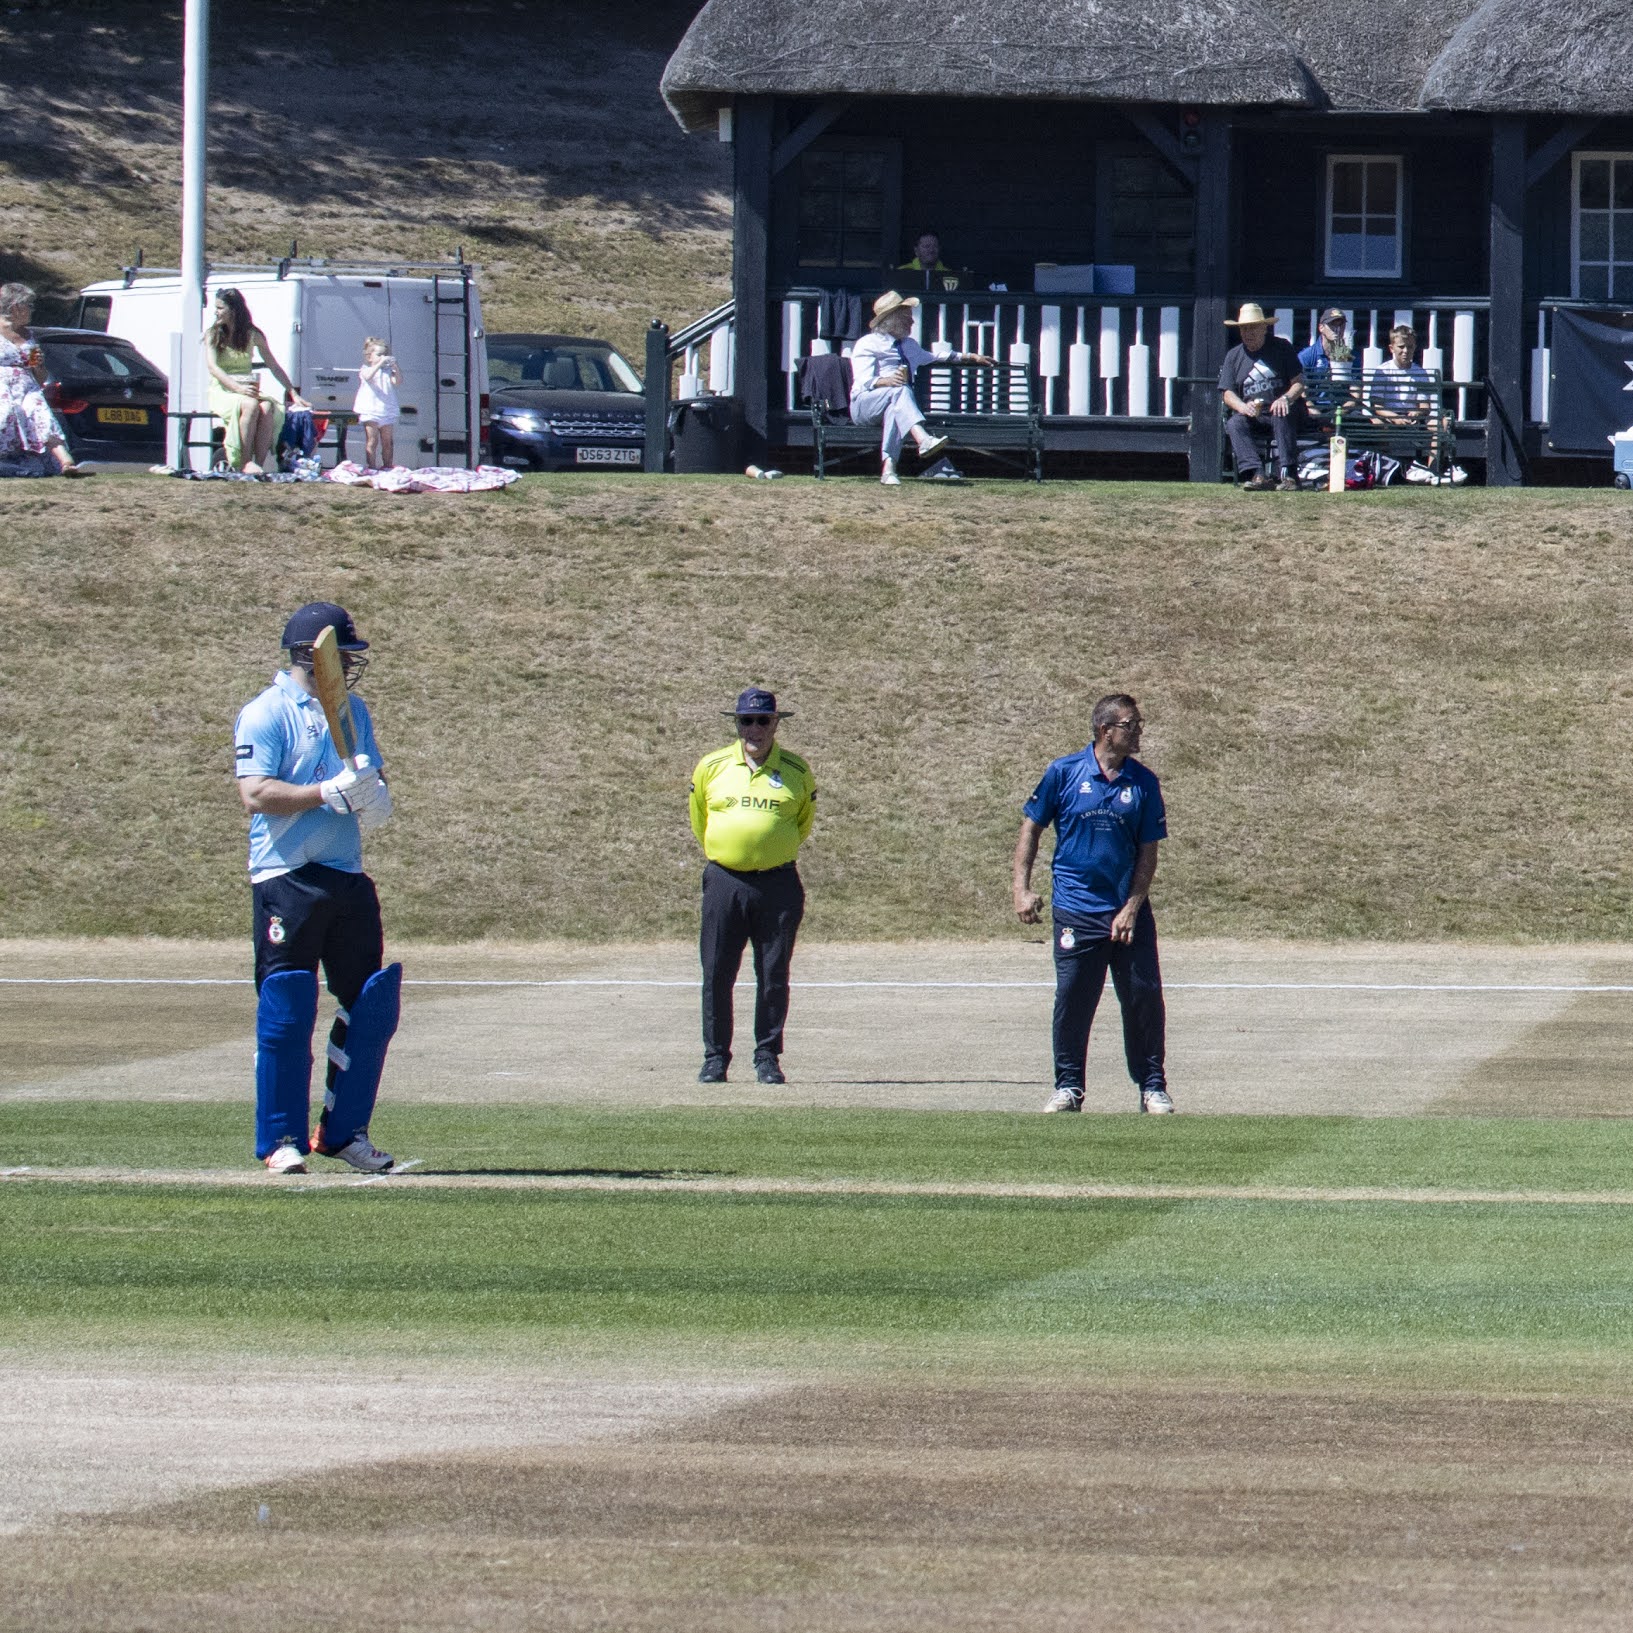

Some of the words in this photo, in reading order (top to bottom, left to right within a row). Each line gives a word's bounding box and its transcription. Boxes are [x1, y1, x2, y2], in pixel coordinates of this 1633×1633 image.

[581, 449, 611, 461] DS63
[614, 450, 636, 462] ZTG
[741, 796, 780, 810] BMF
